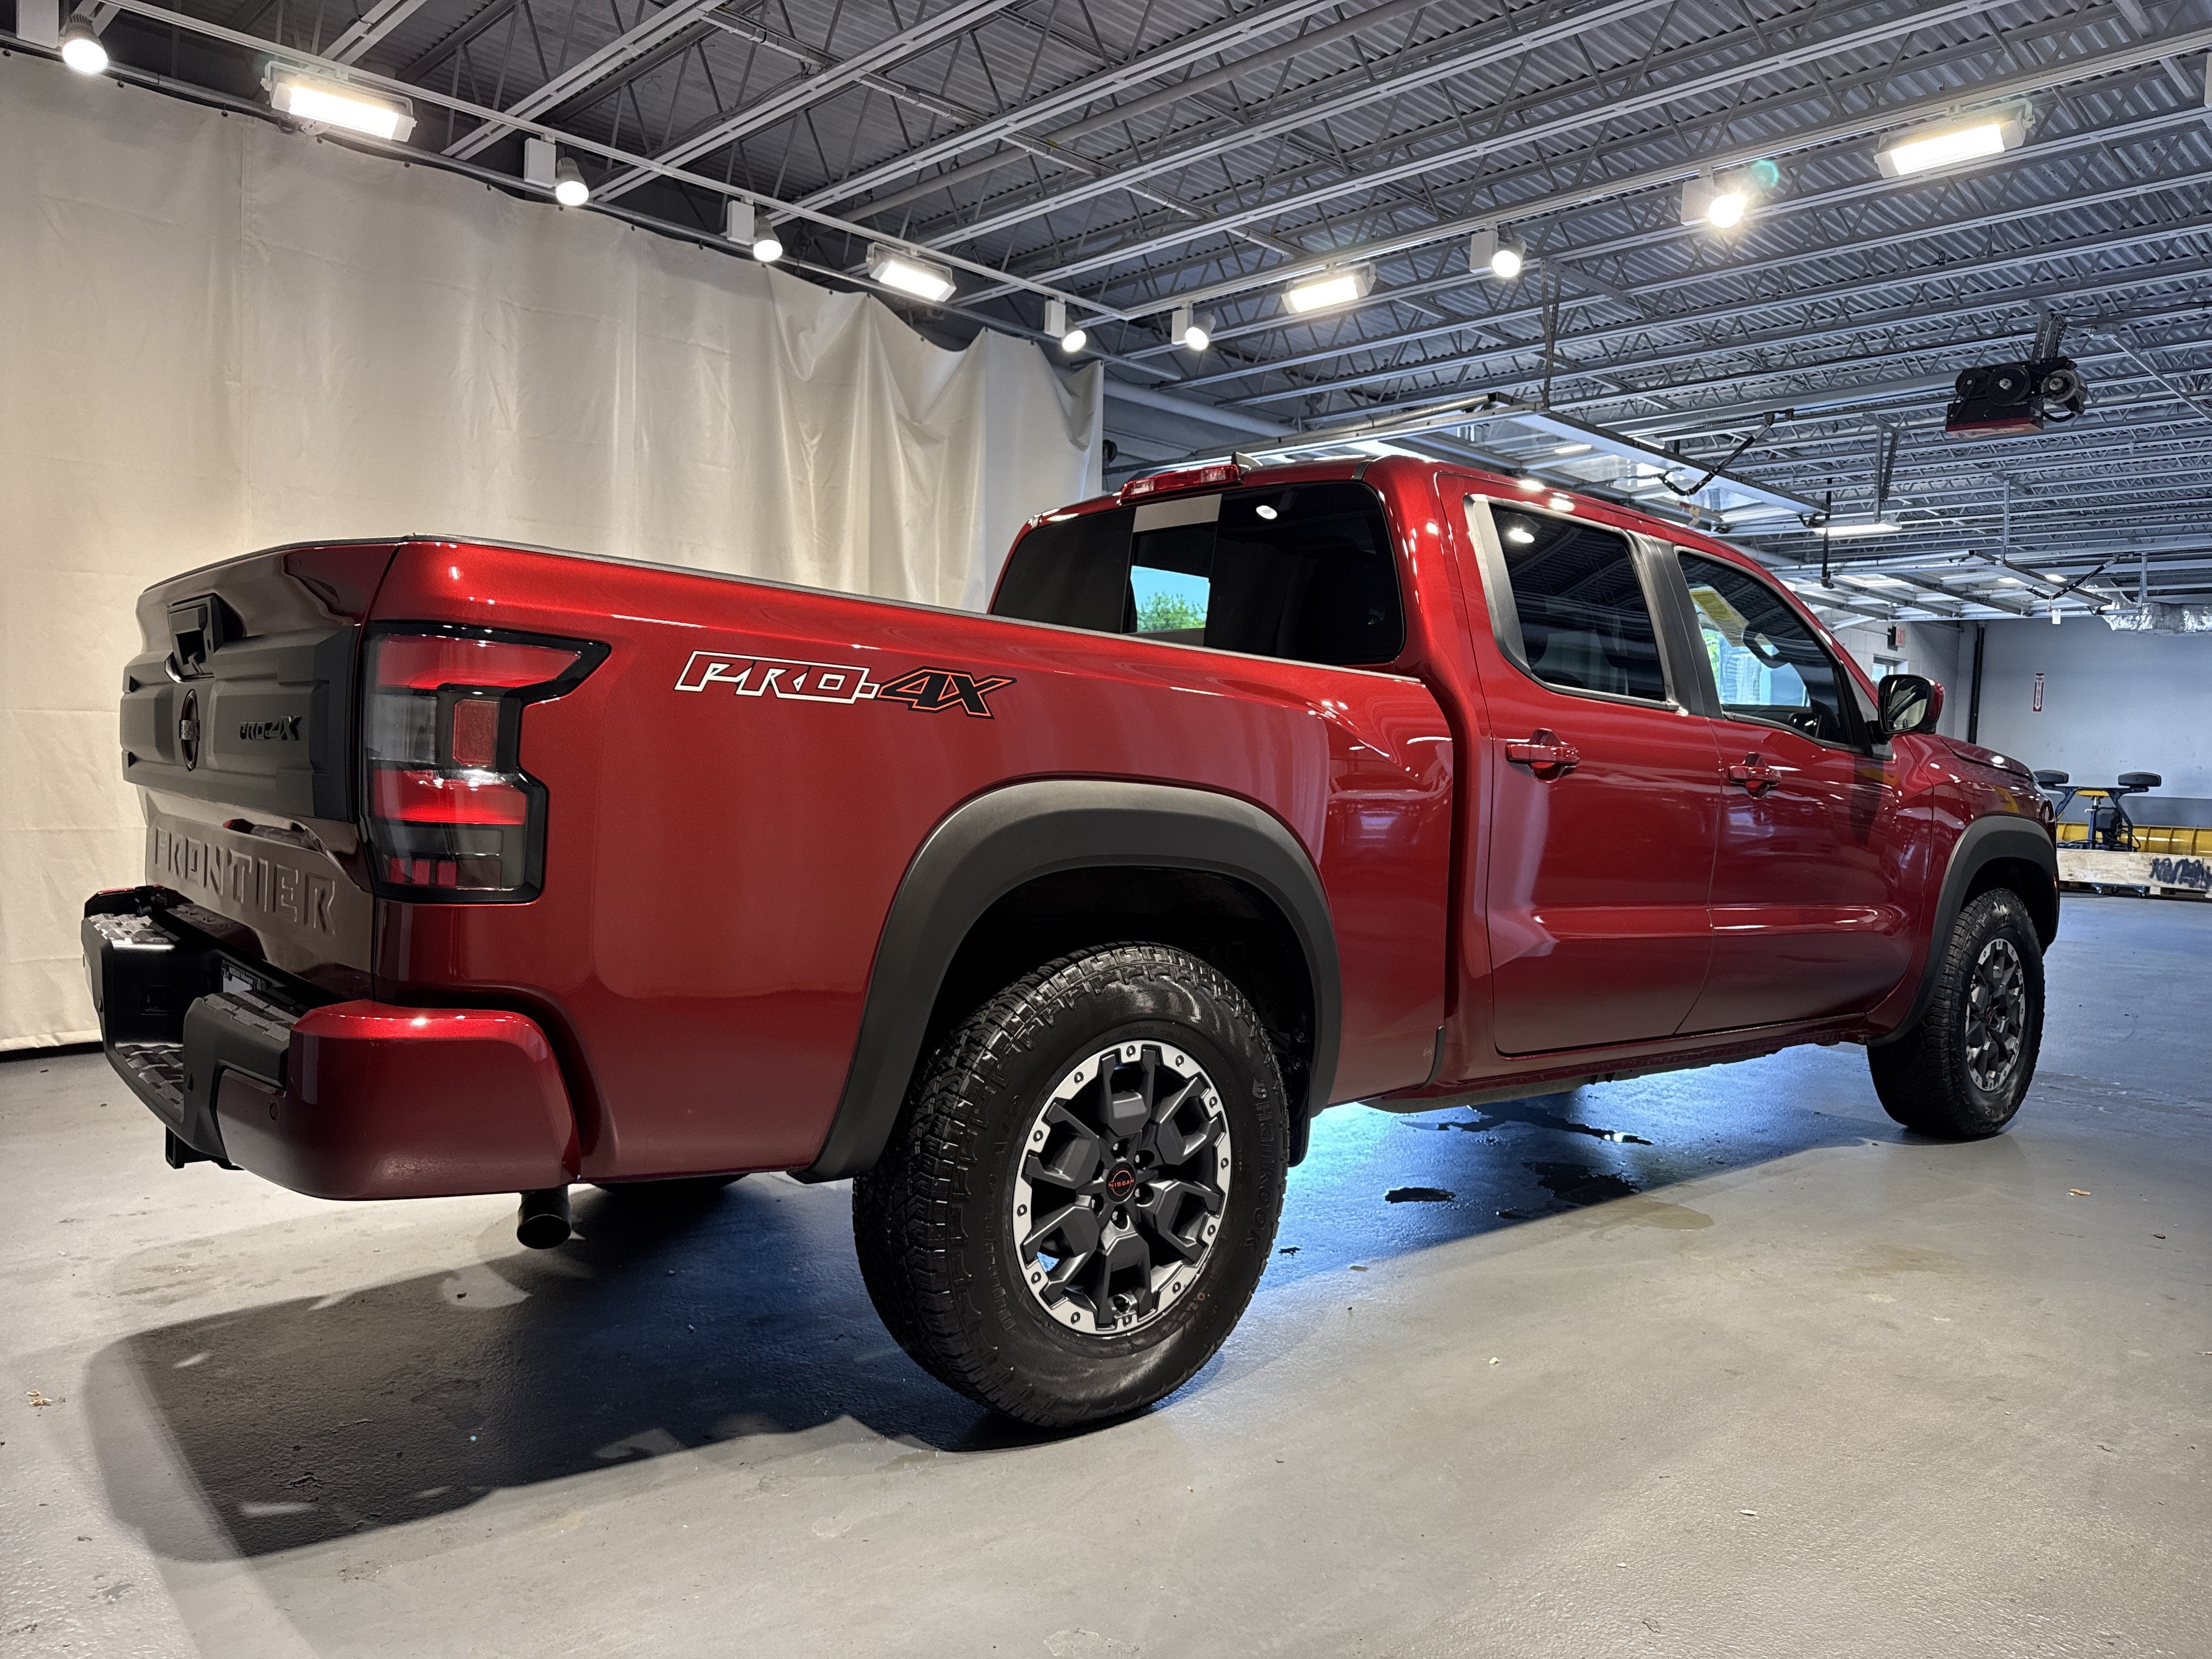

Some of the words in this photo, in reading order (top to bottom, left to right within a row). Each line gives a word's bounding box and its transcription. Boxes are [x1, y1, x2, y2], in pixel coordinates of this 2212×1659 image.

[673, 650, 1017, 720] PRO-4X
[155, 827, 336, 935] FRONTIER
[1108, 1178, 1135, 1188] NISSAN
